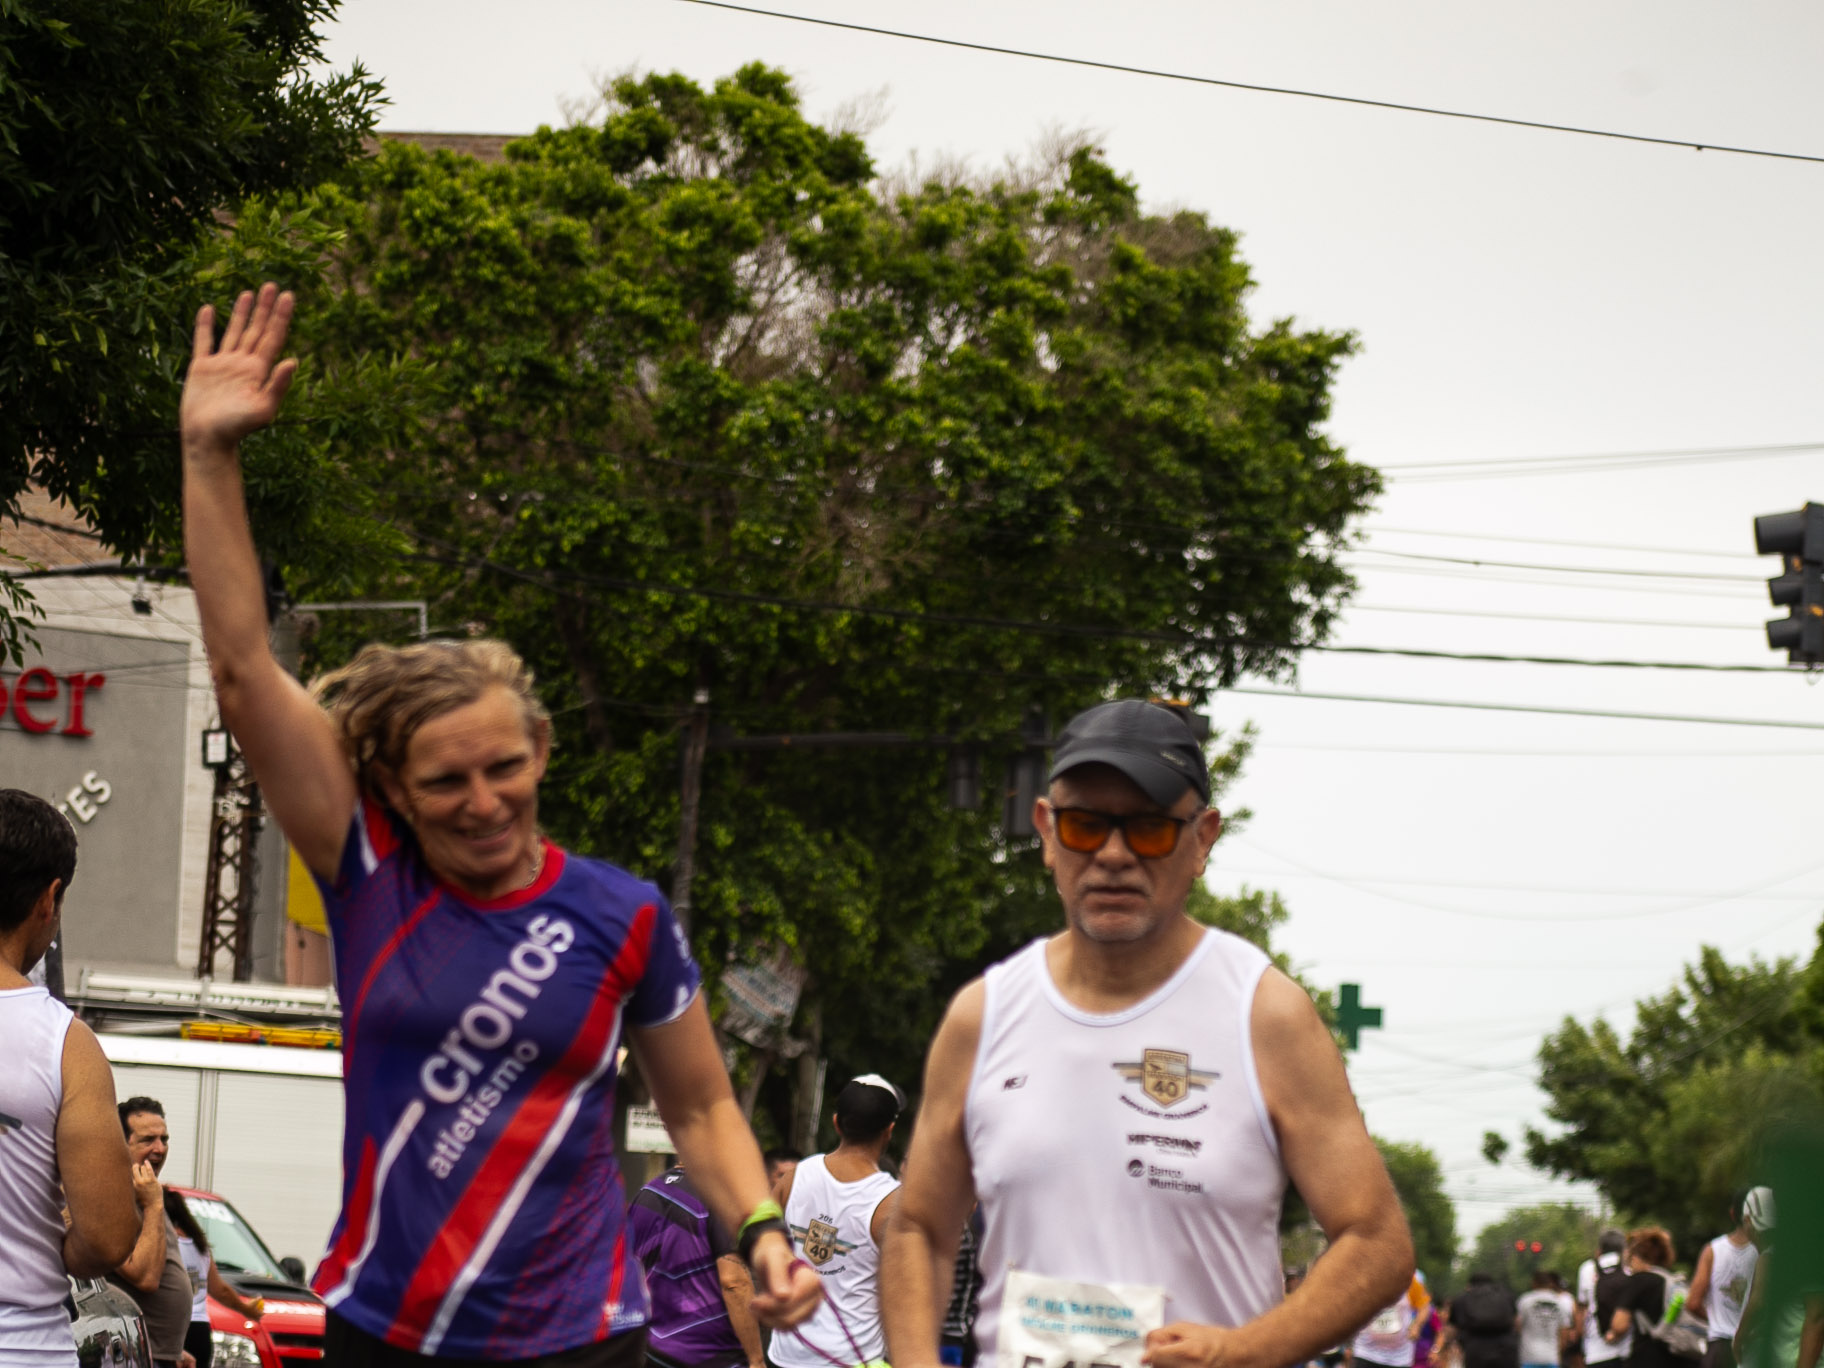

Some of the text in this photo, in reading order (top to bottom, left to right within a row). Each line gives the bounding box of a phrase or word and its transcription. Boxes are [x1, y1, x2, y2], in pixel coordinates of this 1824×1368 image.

[0, 667, 105, 737] er
[58, 769, 112, 822] ES
[420, 913, 575, 1104] cronos
[427, 1040, 540, 1181] atletismo
[810, 1244, 828, 1260] 40
